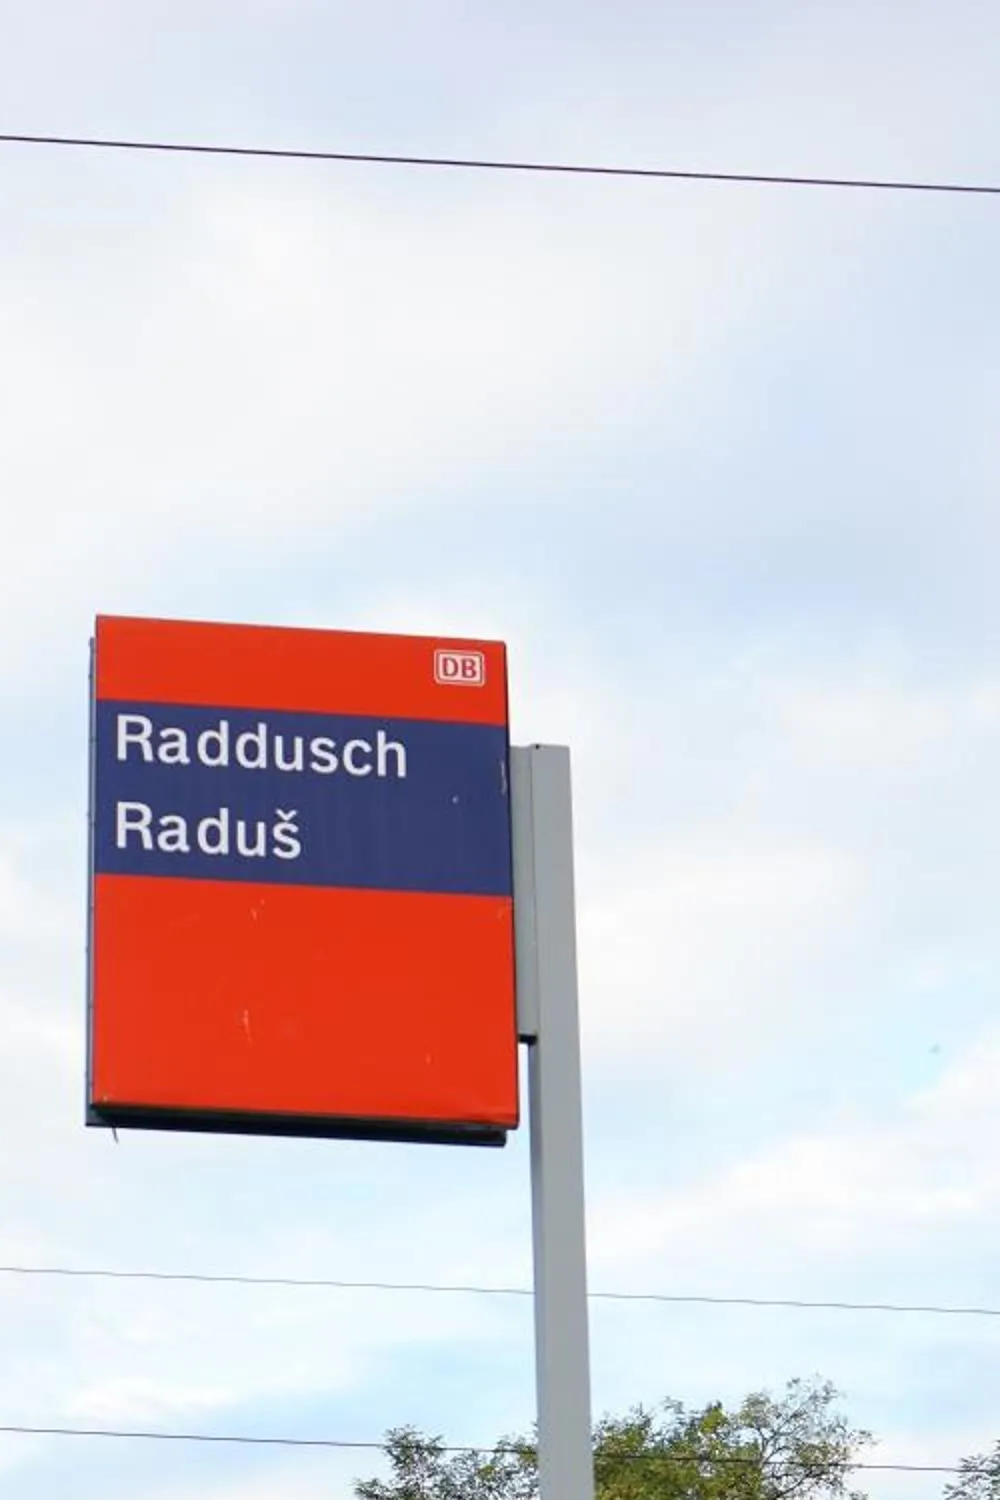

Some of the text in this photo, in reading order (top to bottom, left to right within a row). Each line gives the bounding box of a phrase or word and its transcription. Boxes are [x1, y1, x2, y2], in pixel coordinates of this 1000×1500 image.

[441, 656, 477, 679] DB
[116, 714, 407, 778] Raddusch
[115, 801, 302, 859] Raduš
